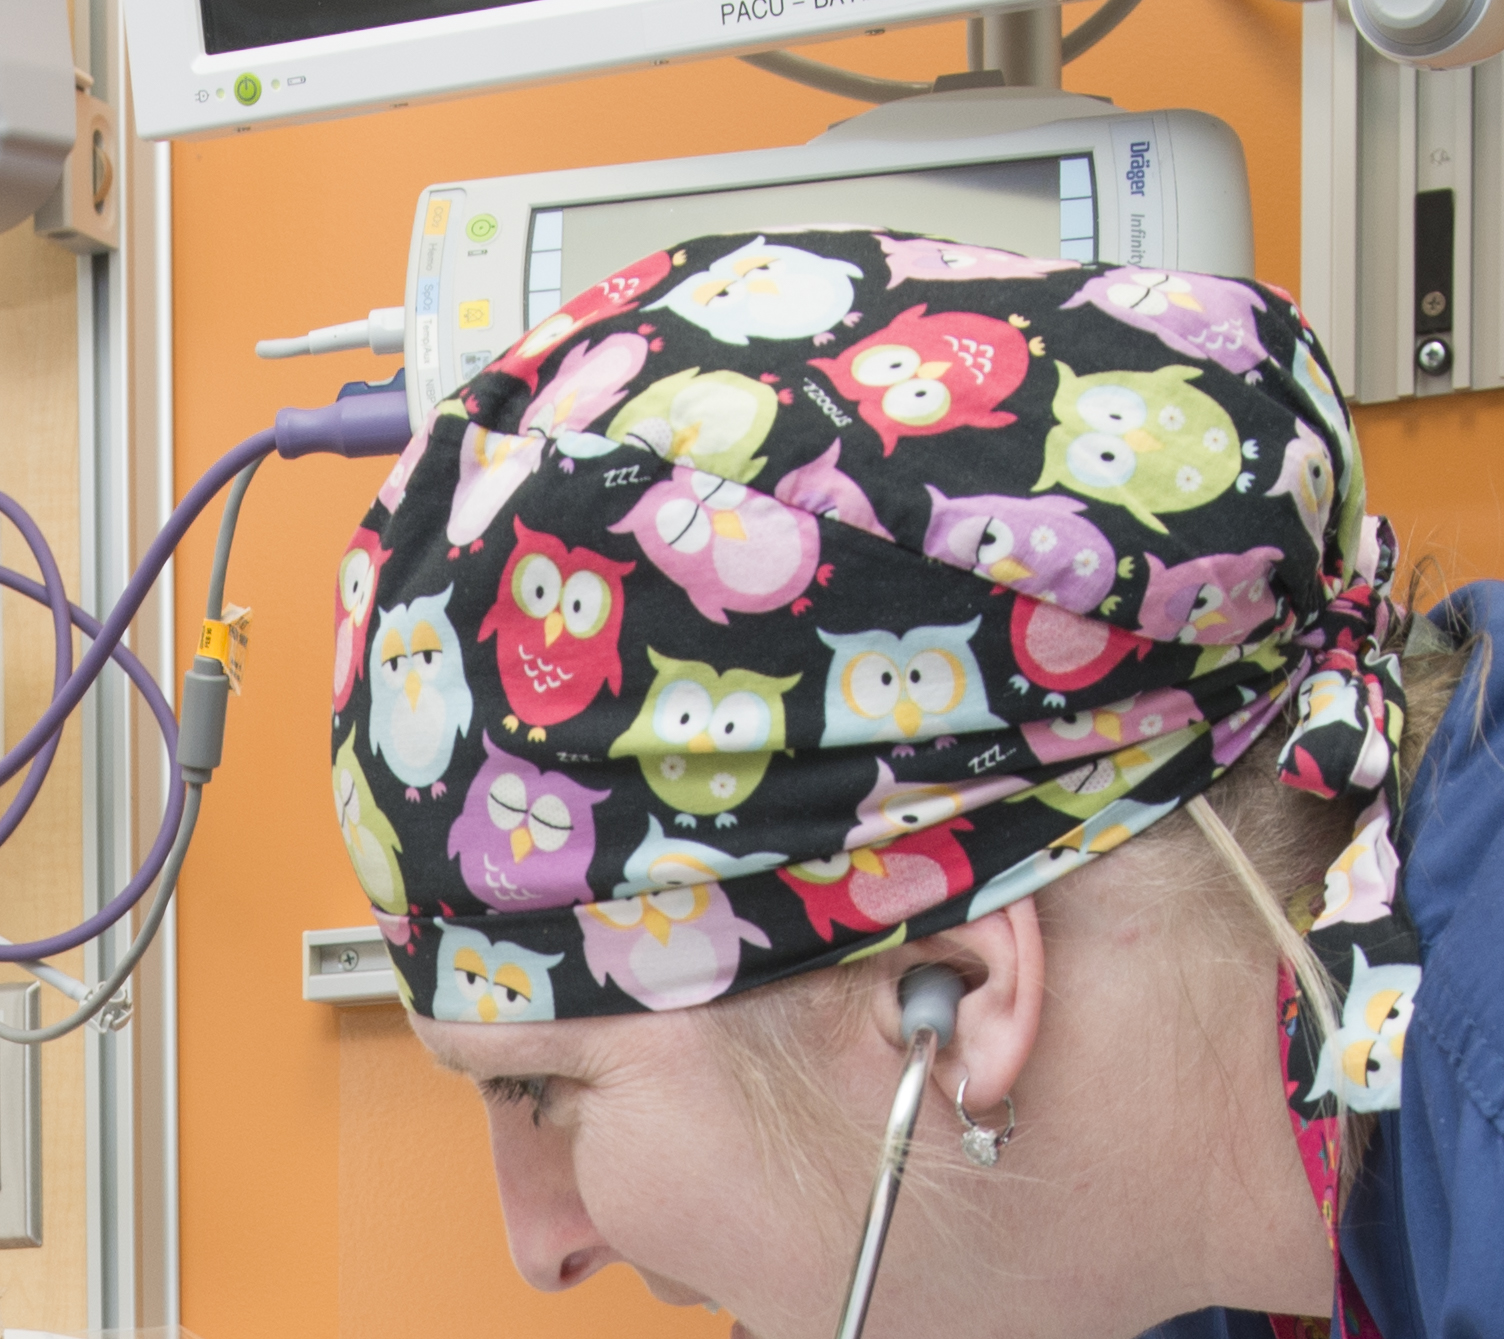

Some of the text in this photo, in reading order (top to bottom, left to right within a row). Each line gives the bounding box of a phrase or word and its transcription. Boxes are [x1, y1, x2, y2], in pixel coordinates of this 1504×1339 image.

[721, 0, 785, 25] PACU
[1126, 141, 1150, 197] Dräger
[1127, 213, 1146, 266] Infinity
[426, 242, 438, 272] Hemo
[423, 284, 434, 311] SpO2
[422, 318, 433, 364] Temp/Aux
[425, 378, 436, 403] NIBP
